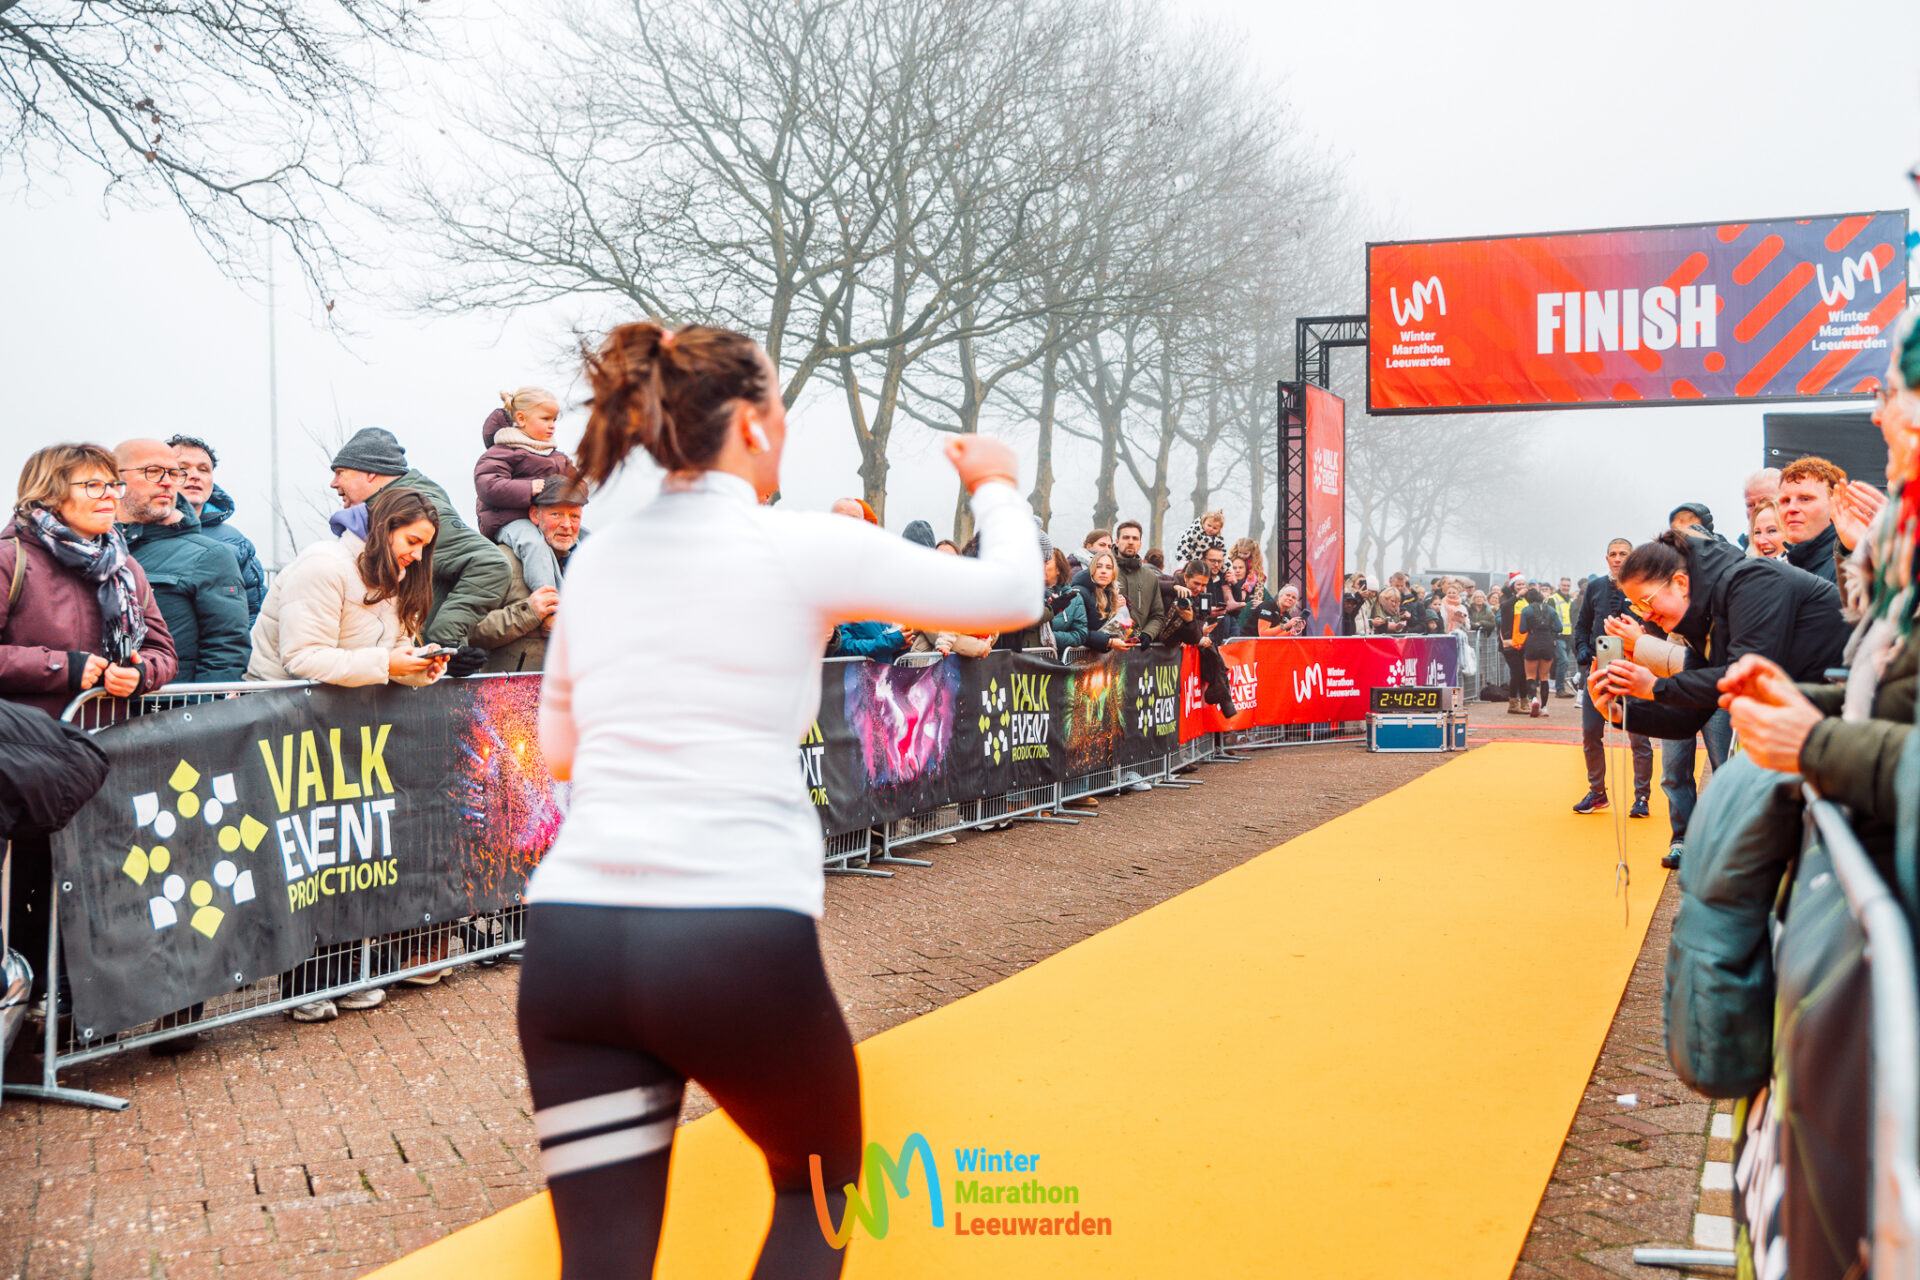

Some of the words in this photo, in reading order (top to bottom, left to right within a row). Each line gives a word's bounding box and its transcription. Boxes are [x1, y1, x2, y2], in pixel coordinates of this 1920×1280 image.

[1537, 284, 1717, 355] FINISH
[1828, 310, 1870, 322] Winter
[1400, 330, 1436, 342] Winter
[1819, 323, 1879, 337] Marathon
[1392, 342, 1444, 355] Marathon
[1811, 337, 1887, 351] Leeuwarden
[1386, 355, 1451, 368] Leeuwarden
[1326, 667, 1346, 677] Winter
[1326, 677, 1354, 687] Marathon
[1010, 673, 1052, 711] VALK
[1326, 687, 1360, 698] Leeuwarden
[1380, 692, 1437, 707] 2:40:20
[1011, 713, 1050, 746] EVENT
[1011, 744, 1050, 762] PRODUCTIONS
[258, 724, 395, 813] VALK
[275, 798, 396, 882] EVENT
